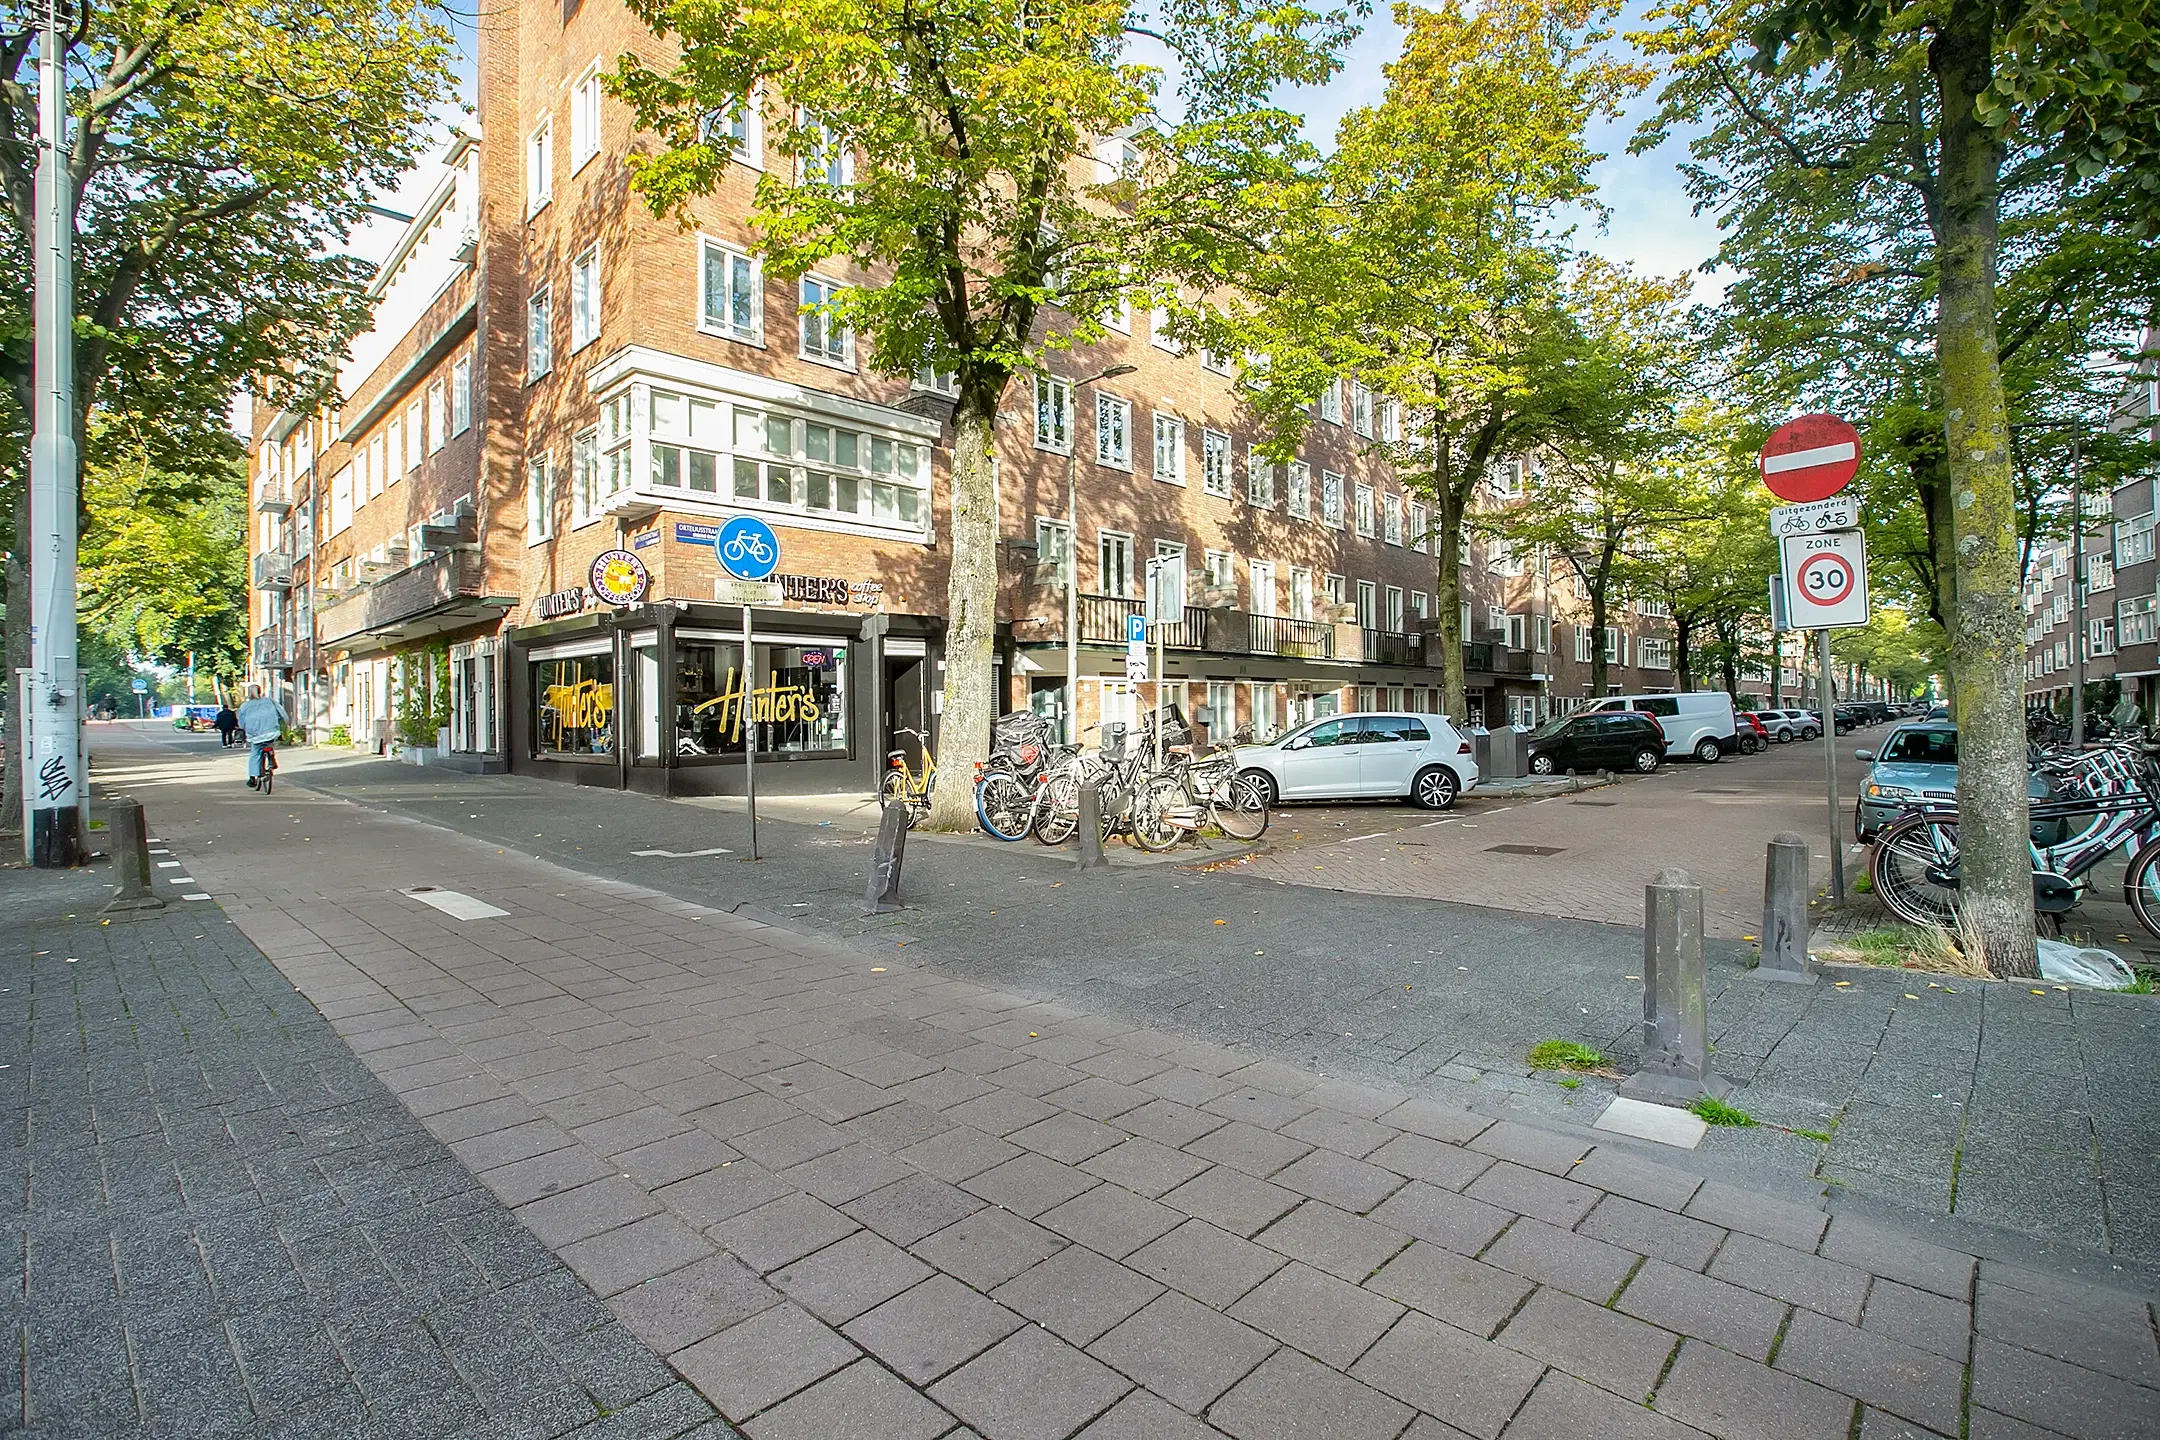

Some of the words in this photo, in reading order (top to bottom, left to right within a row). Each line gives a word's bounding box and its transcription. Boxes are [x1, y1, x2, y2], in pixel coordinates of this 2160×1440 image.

[1778, 499, 1847, 516] uitgezonderd
[1805, 537, 1841, 550] ZONE
[759, 574, 849, 602] NTER'S
[850, 579, 883, 593] coffee
[1808, 568, 1844, 590] 30
[596, 577, 644, 603] COFFEESHOP
[852, 591, 880, 608] shop
[537, 587, 580, 618] HUNTER'S
[801, 653, 826, 667] OPEN
[693, 666, 820, 743] Hunter's
